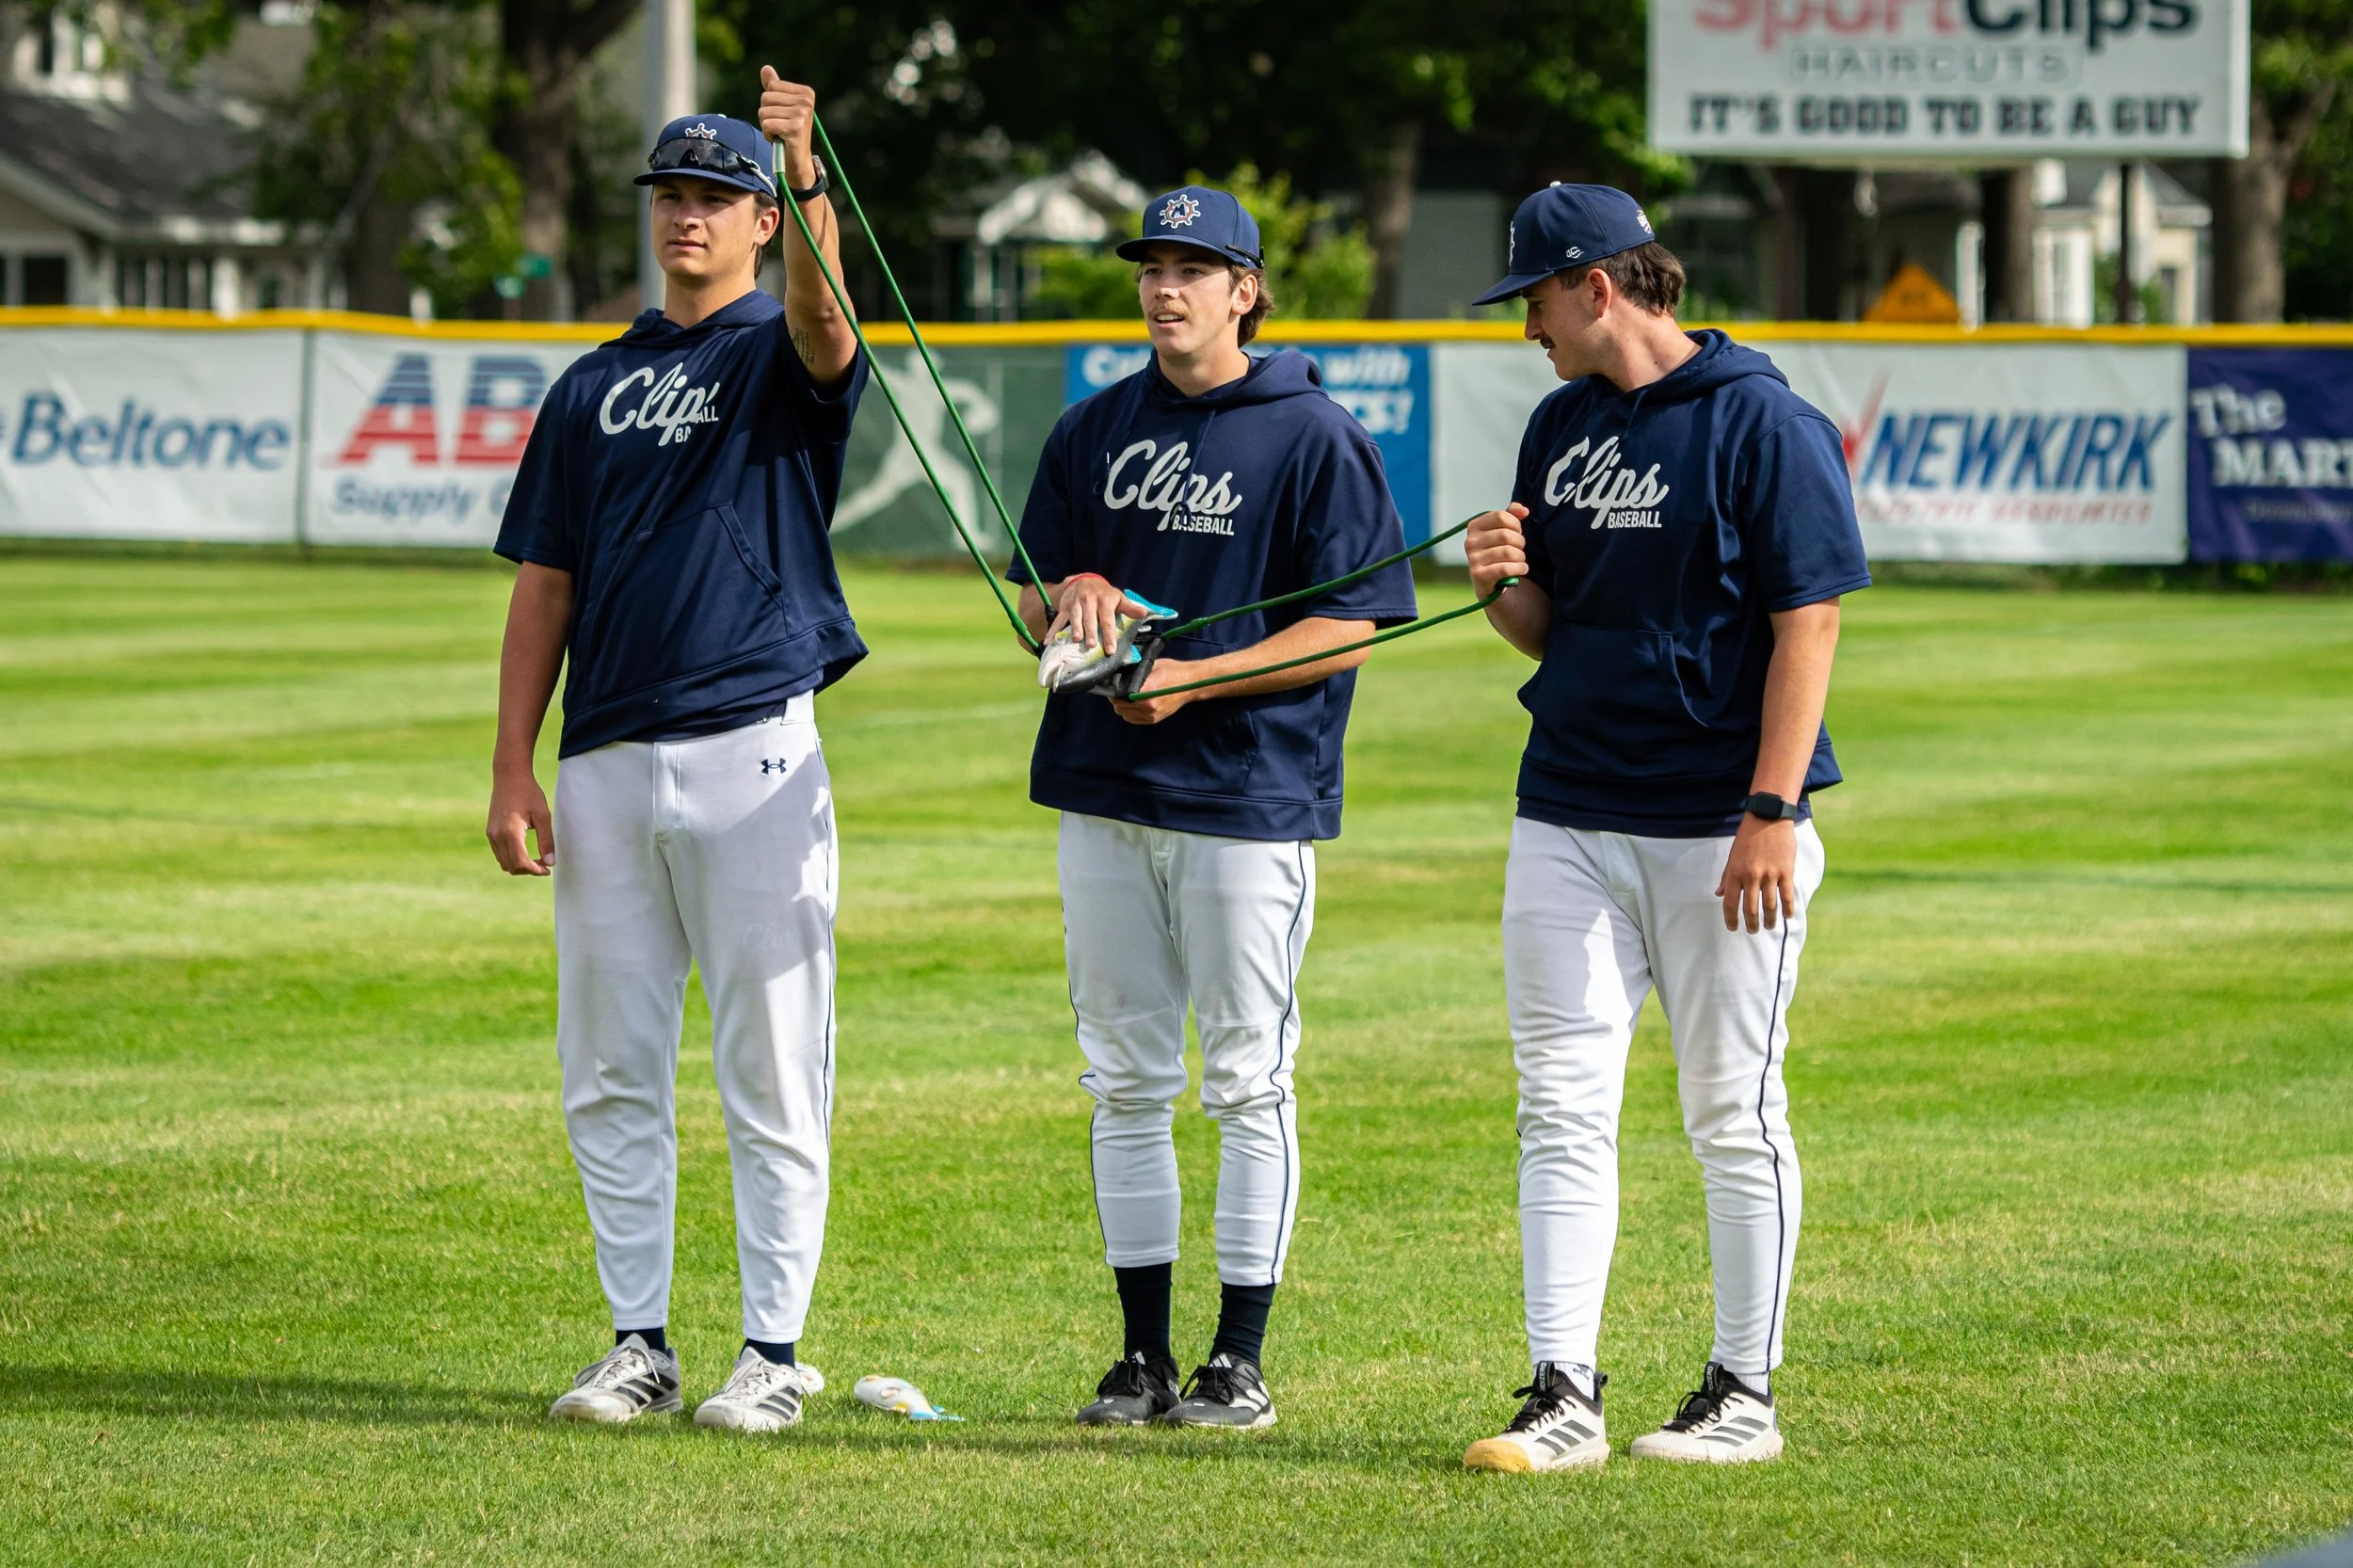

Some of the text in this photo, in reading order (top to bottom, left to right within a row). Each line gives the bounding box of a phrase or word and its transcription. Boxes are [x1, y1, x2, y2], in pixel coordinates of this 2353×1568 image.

[1689, 93, 2201, 136] IT'S GOOD TO BE A GUY
[11, 390, 293, 472] Beltone
[2189, 384, 2287, 439] The
[1860, 409, 2173, 492] NEWKIRK
[333, 476, 475, 524] Supply
[1104, 439, 1243, 532] Clips
[1545, 435, 1670, 530] Clips
[1172, 515, 1235, 536] BASEBALL
[1608, 511, 1662, 529] BASEBALL
